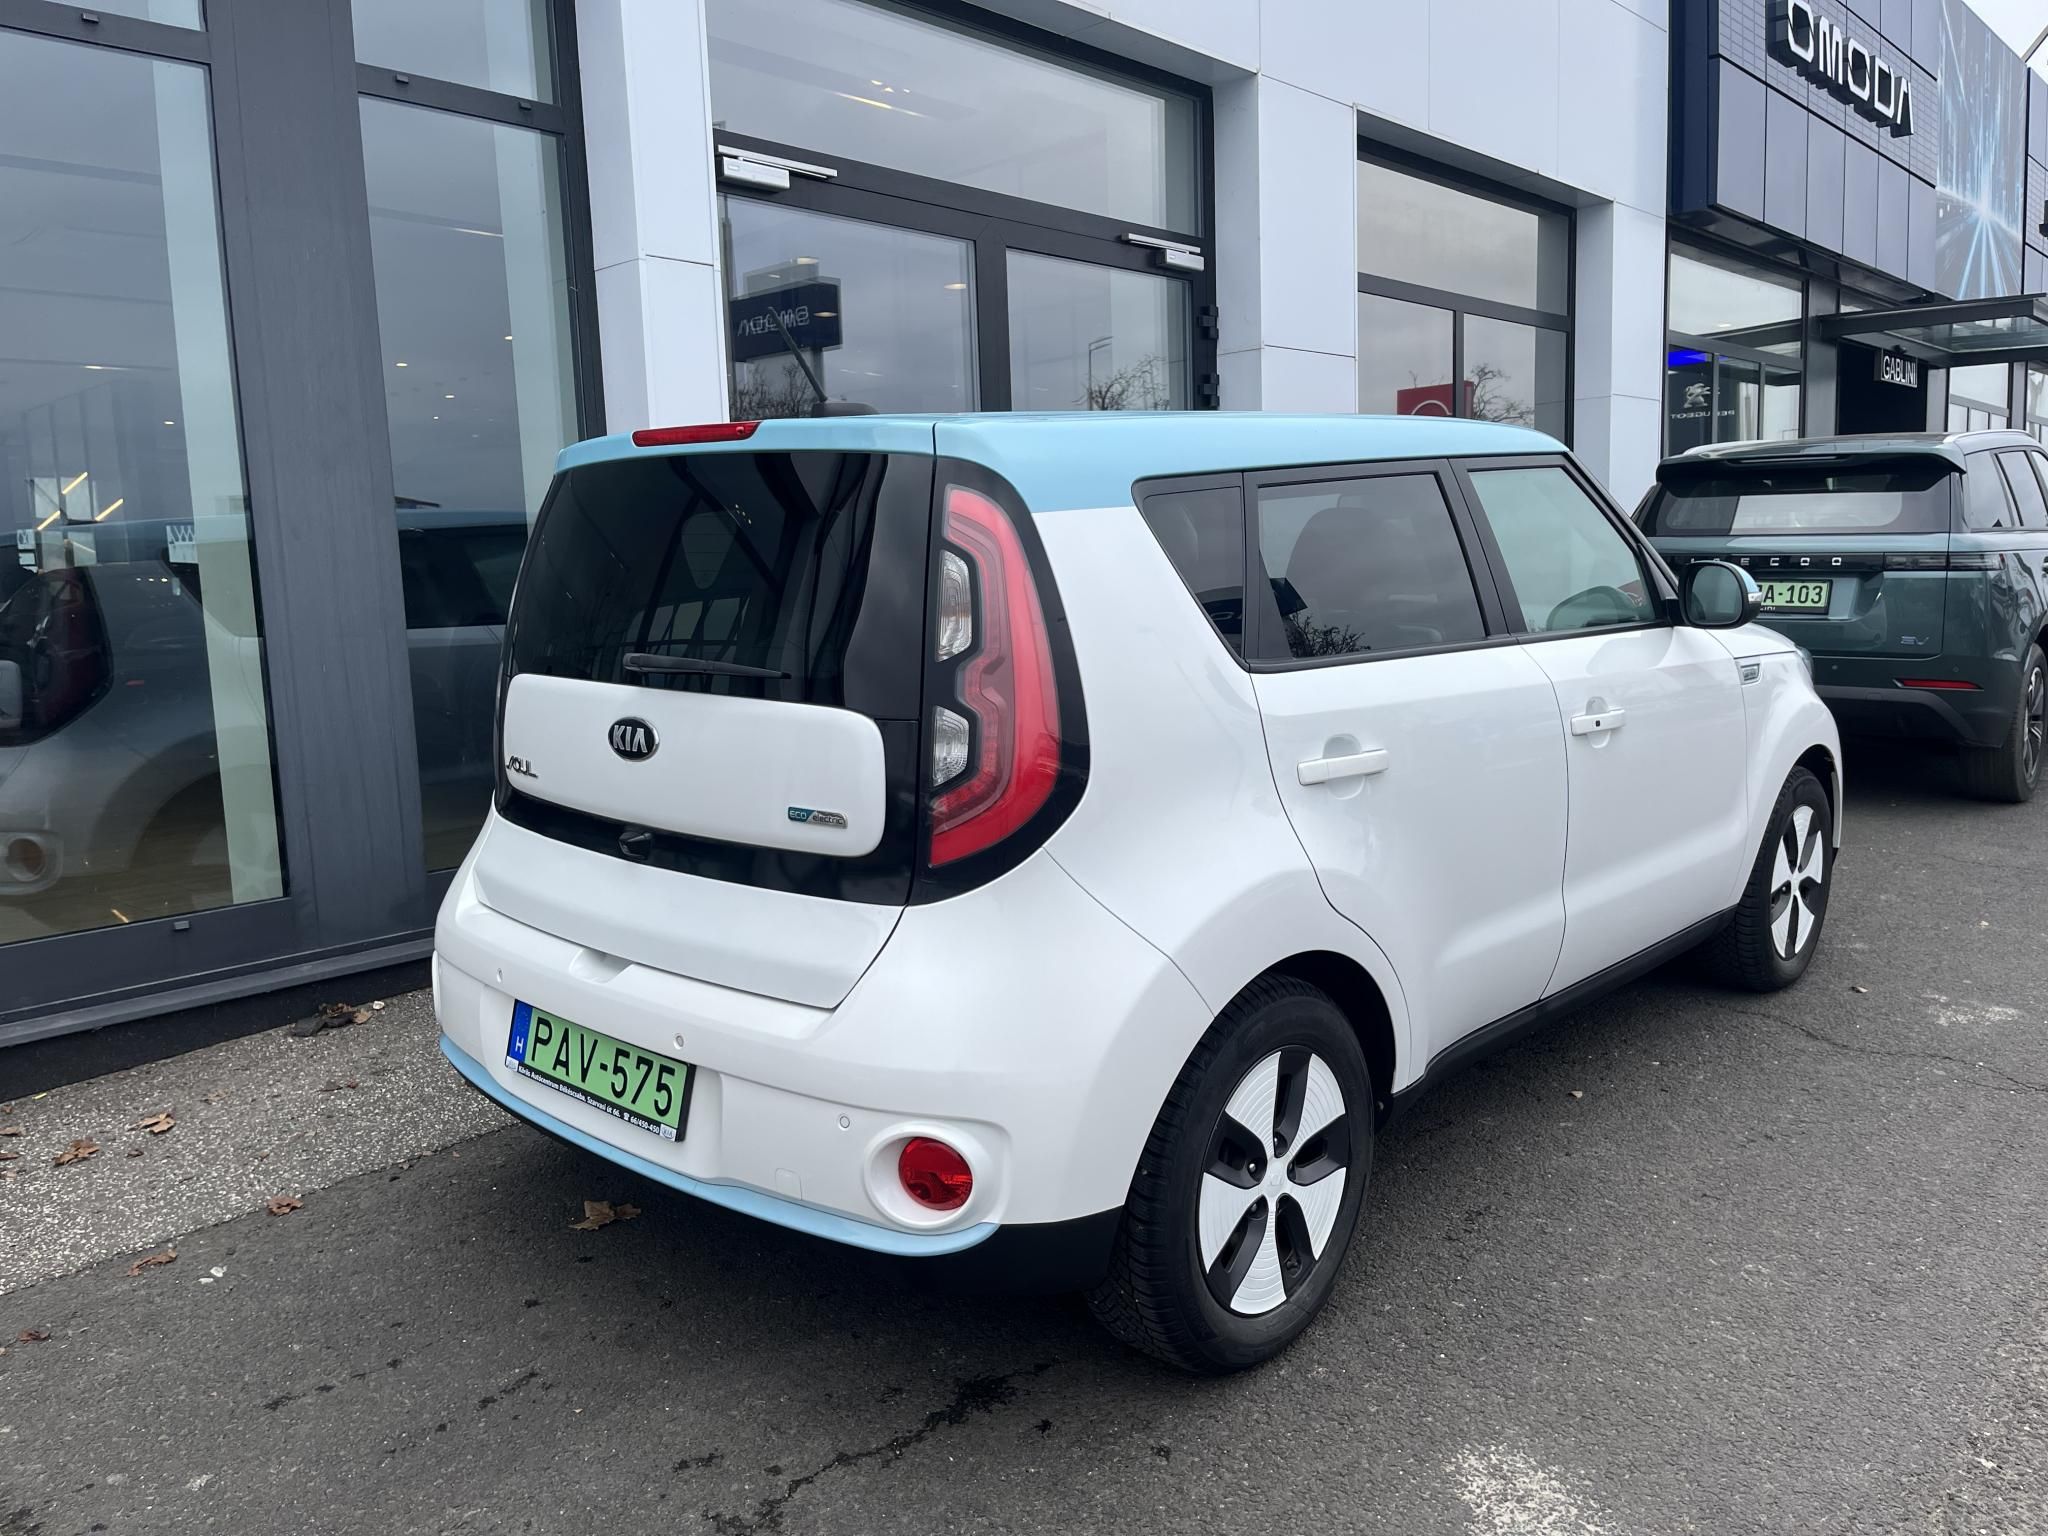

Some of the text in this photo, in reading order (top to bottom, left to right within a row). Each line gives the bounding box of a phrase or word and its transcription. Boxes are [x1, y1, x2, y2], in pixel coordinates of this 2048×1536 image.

[1788, 0, 1914, 134] OMODA
[1883, 355, 1916, 385] GABLINI
[612, 724, 648, 753] KIA
[789, 810, 844, 825] ECO electric
[515, 1036, 524, 1054] H
[531, 1016, 676, 1117] PAV-575
[630, 1116, 660, 1134] 66/450-450
